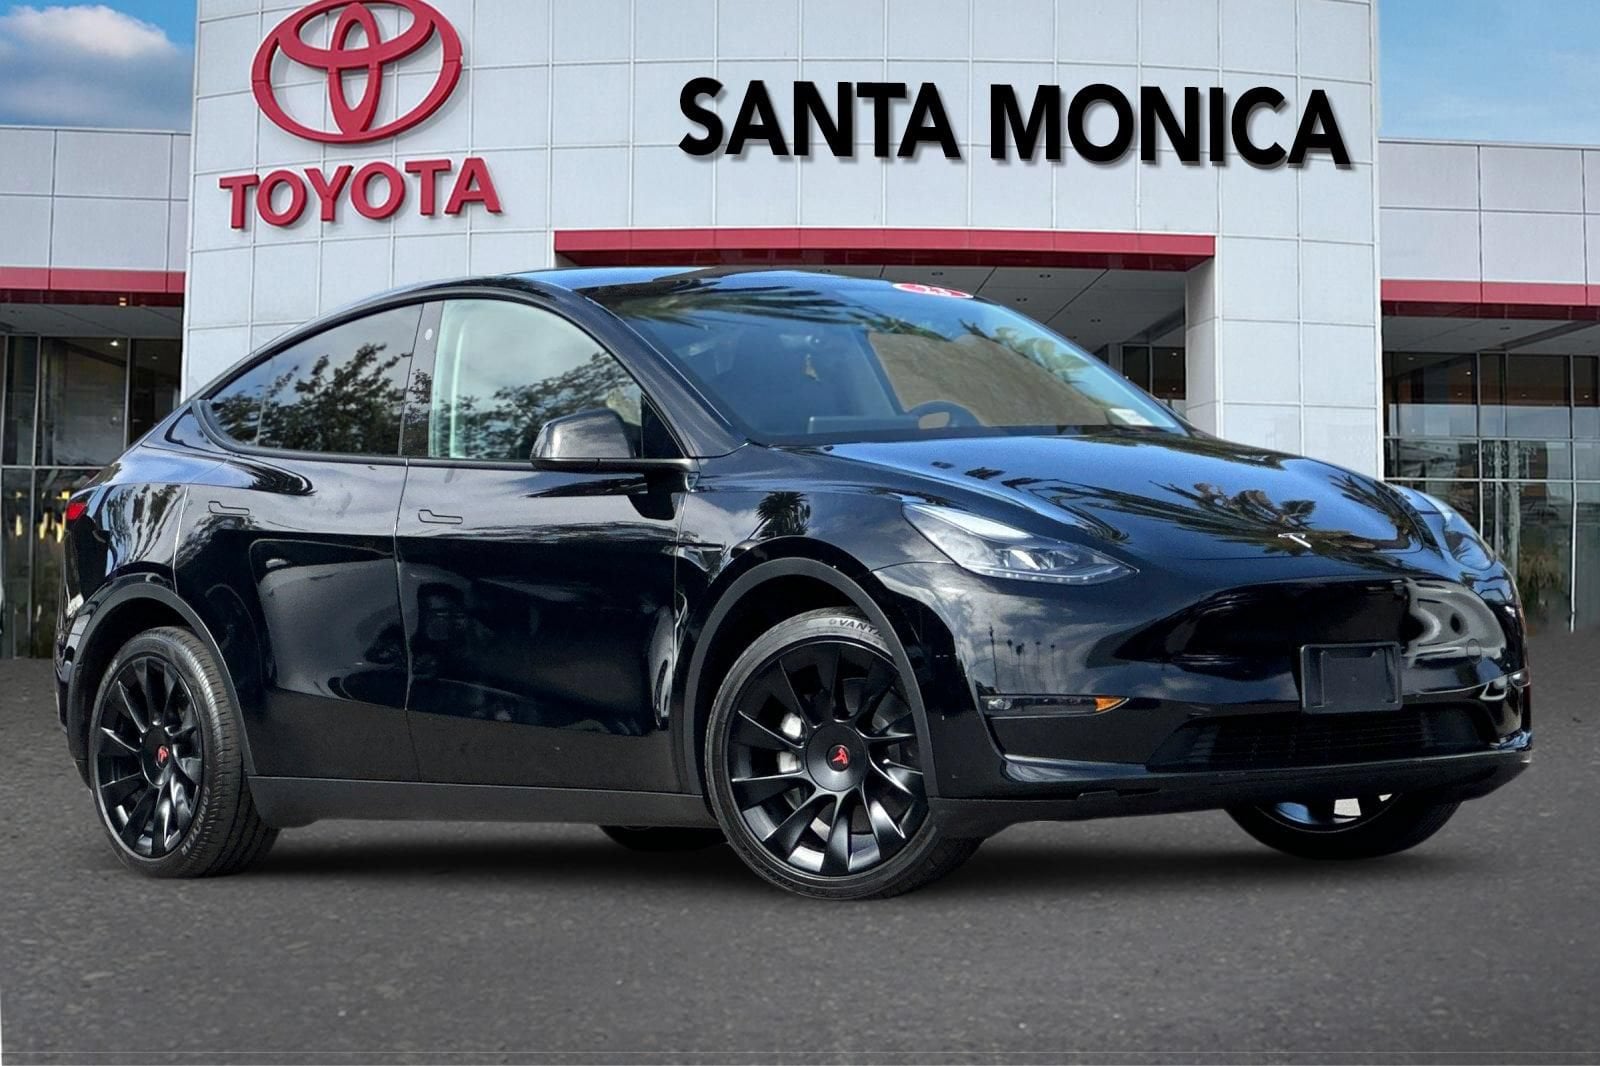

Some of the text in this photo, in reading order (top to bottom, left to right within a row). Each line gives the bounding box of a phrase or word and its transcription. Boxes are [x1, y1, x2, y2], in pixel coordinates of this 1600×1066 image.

[679, 78, 1352, 166] SANTA MONICA
[219, 157, 502, 229] TOYOTA
